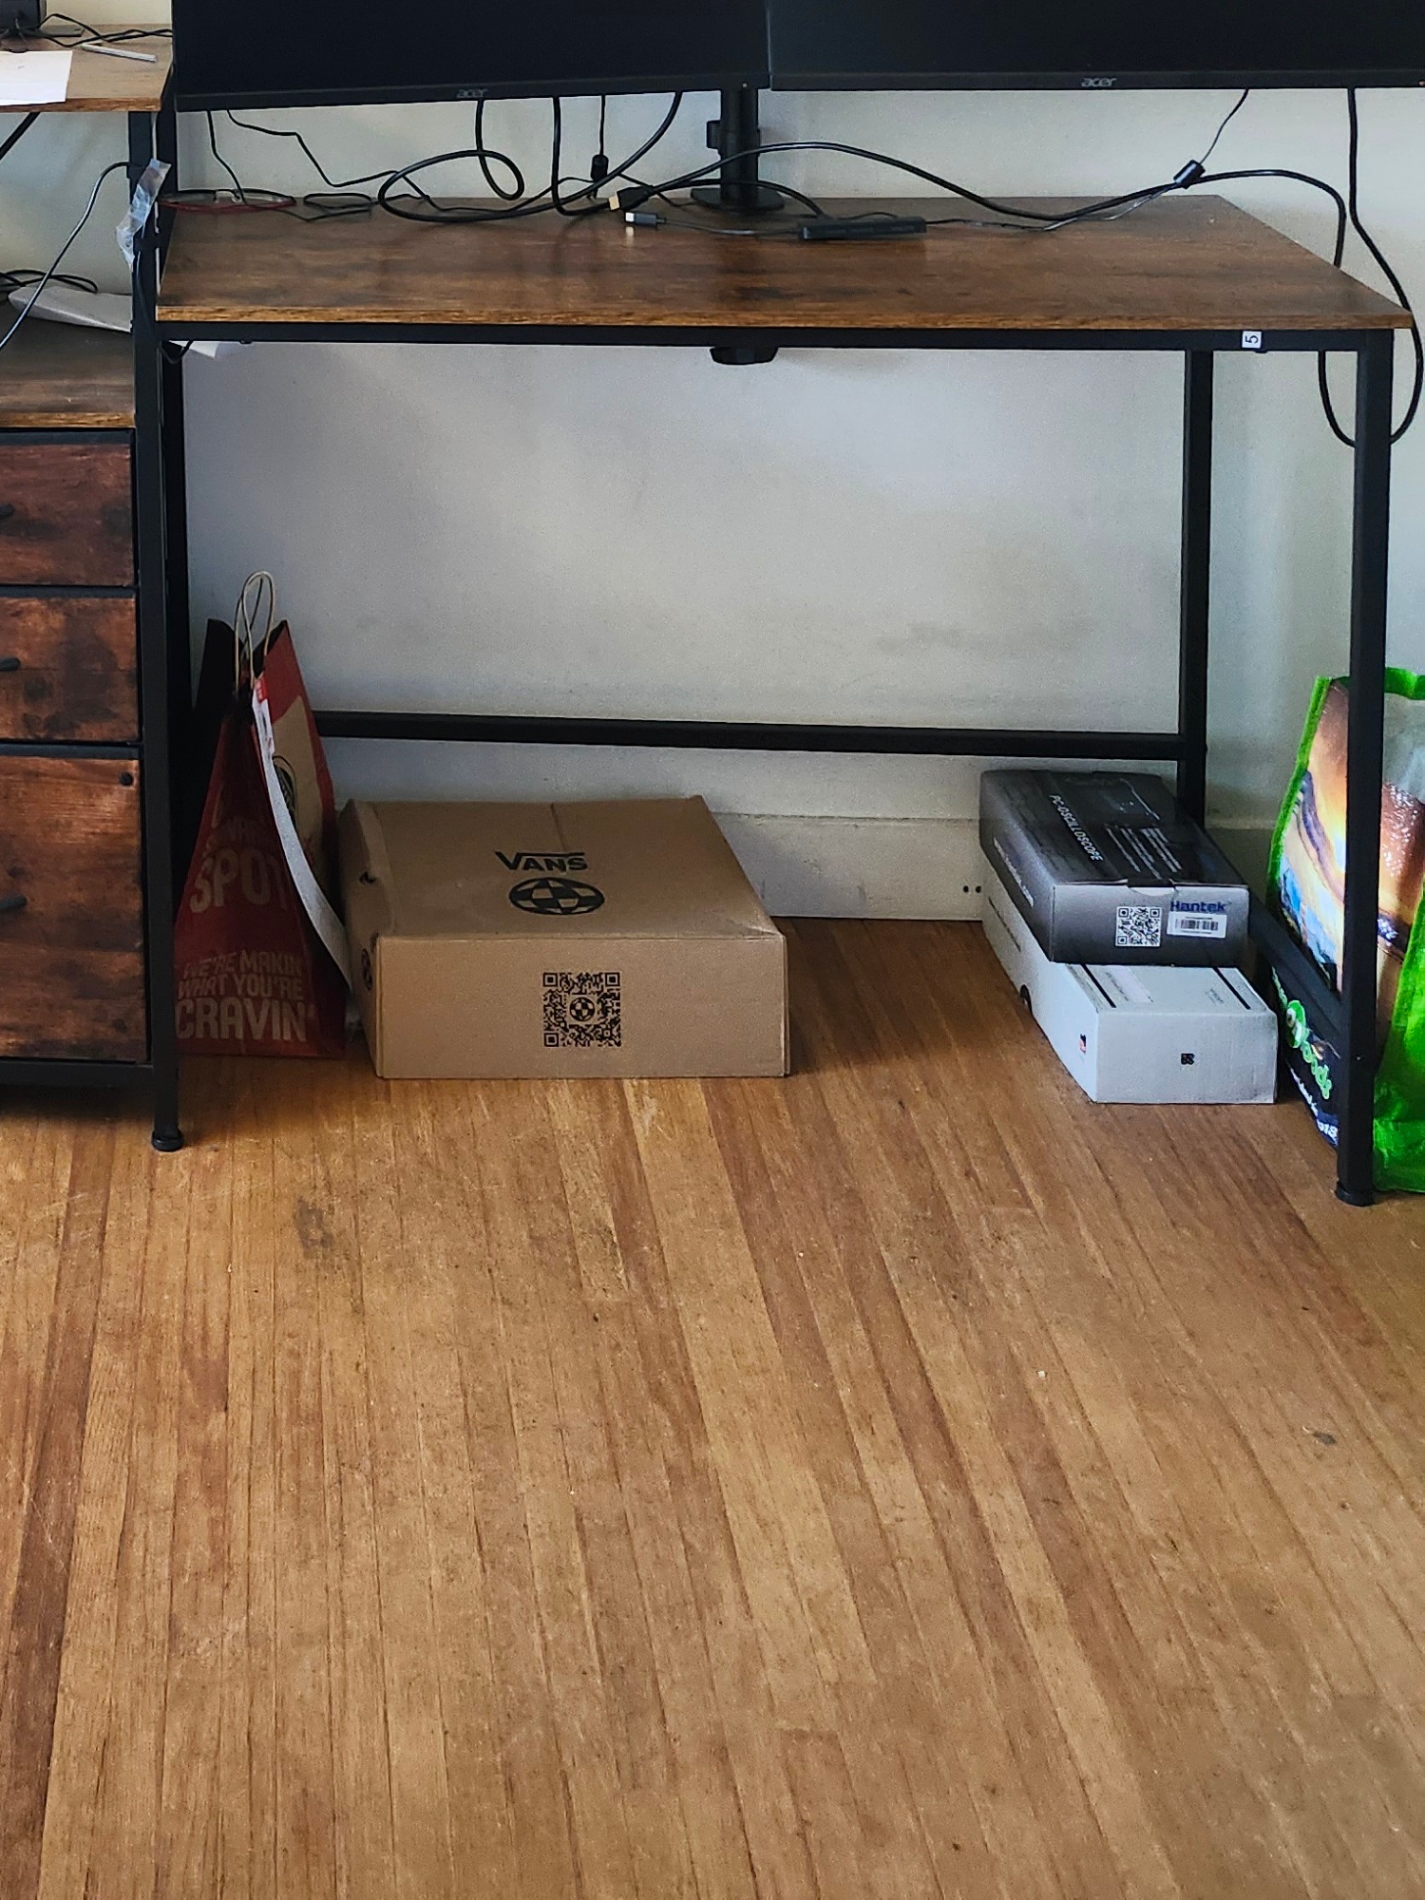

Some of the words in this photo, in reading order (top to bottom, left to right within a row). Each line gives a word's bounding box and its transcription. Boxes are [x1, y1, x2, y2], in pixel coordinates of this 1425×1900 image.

[1081, 77, 1118, 88] acer
[1245, 335, 1259, 344] 5
[494, 851, 588, 872] VANS
[1170, 900, 1227, 913] Hantek
[178, 973, 229, 1000] WHAT
